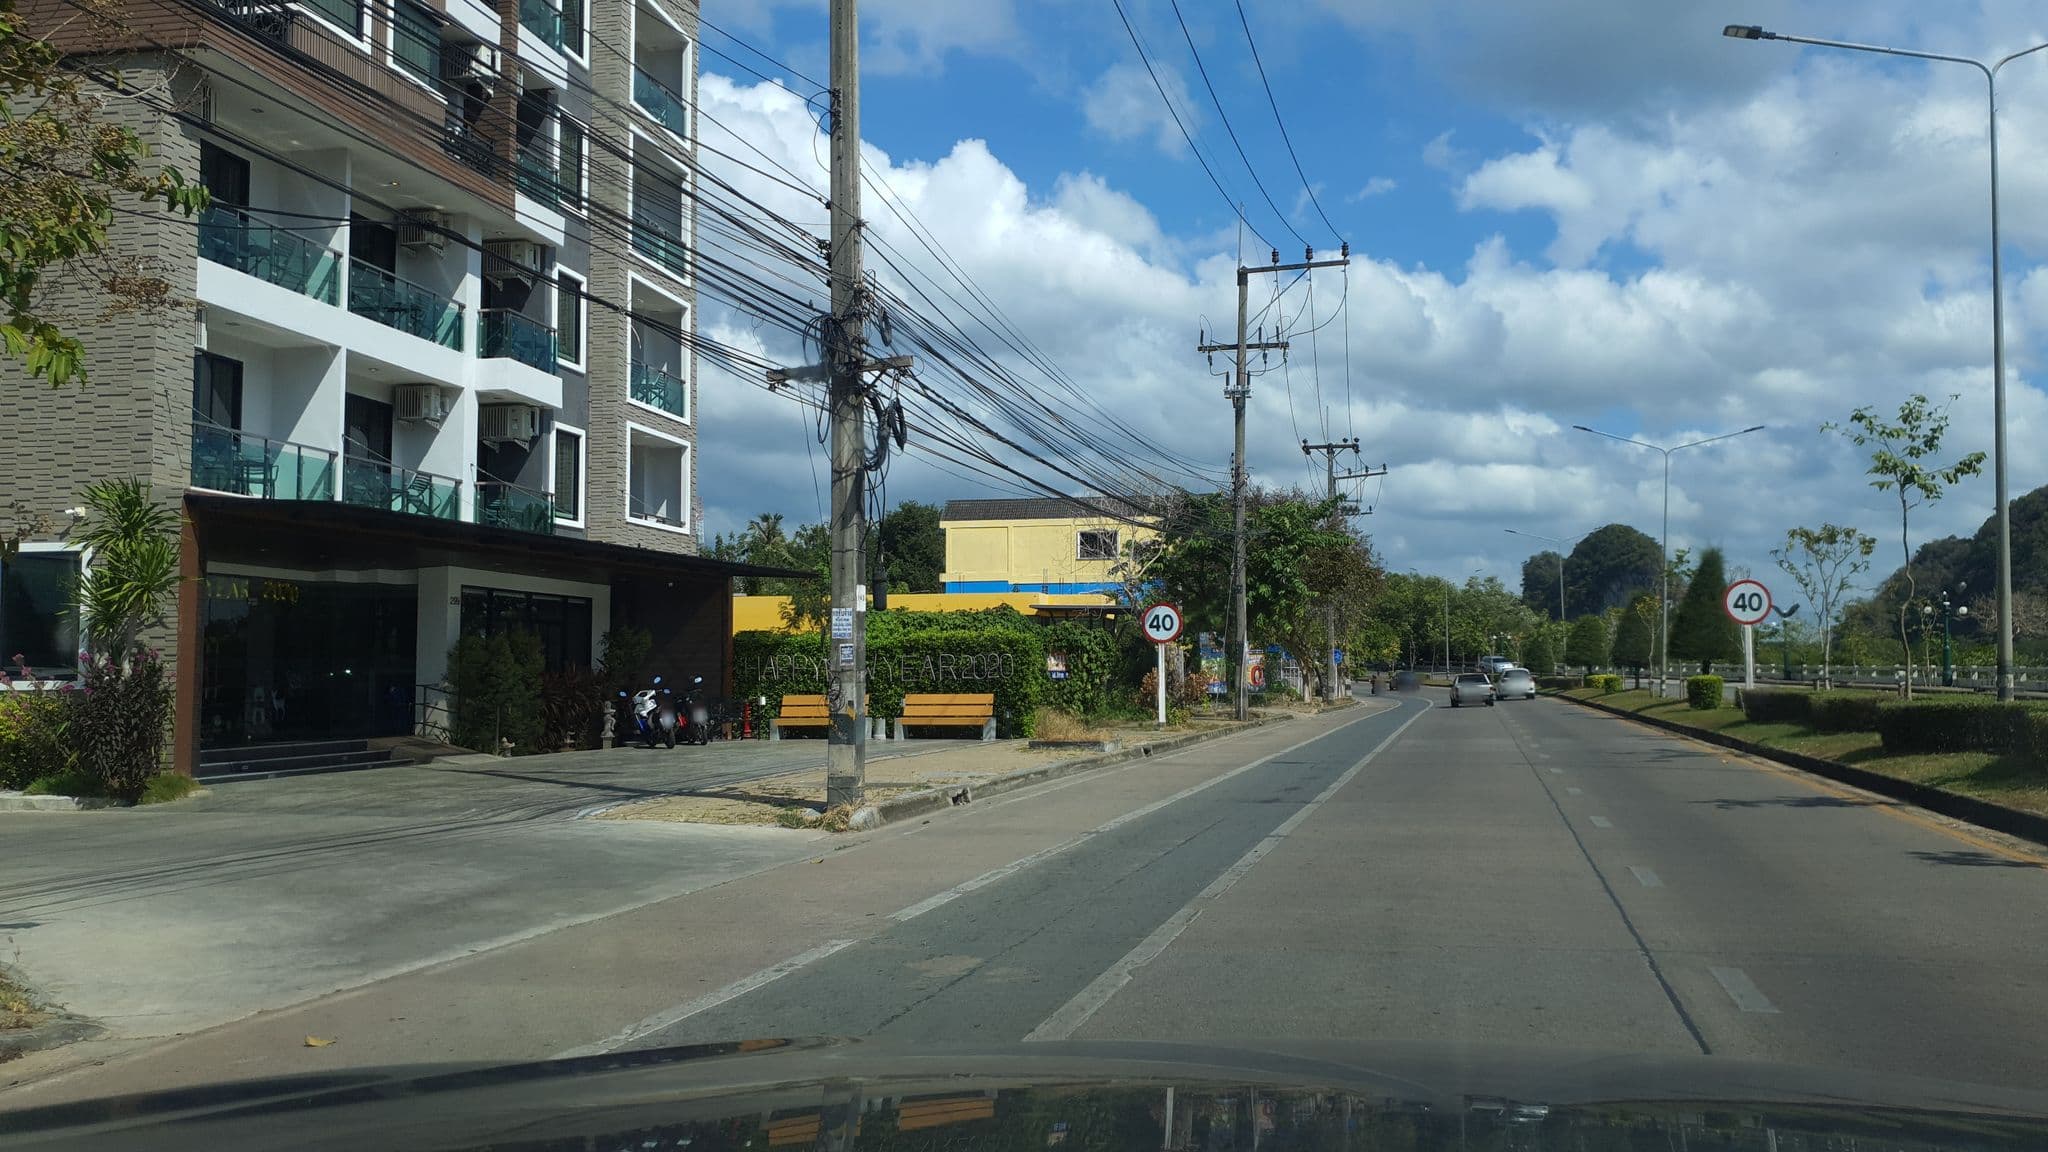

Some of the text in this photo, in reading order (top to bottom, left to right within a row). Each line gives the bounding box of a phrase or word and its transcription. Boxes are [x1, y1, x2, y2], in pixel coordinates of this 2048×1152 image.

[1733, 592, 1763, 612] 40
[1149, 614, 1174, 632] 40
[744, 654, 823, 682] HAPPY
[883, 653, 957, 681] YEAR
[961, 653, 1014, 680] 2020
